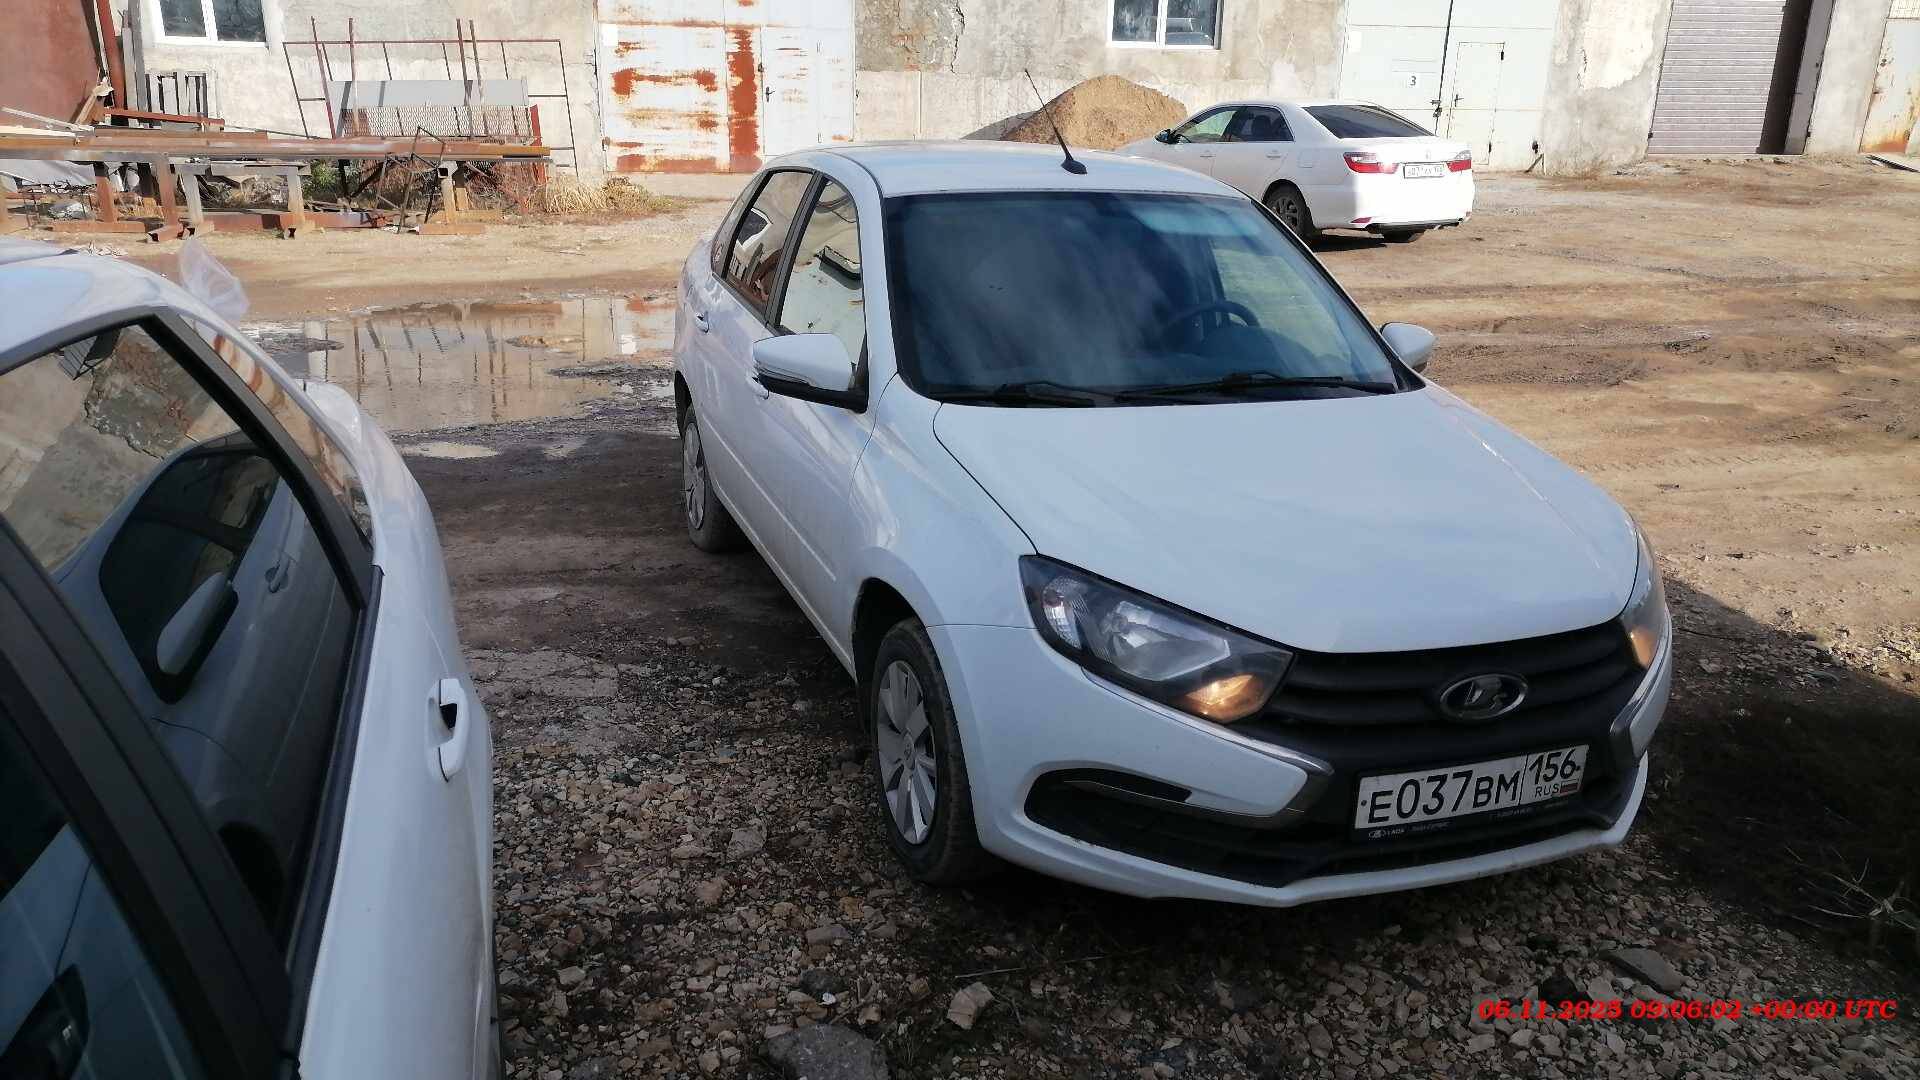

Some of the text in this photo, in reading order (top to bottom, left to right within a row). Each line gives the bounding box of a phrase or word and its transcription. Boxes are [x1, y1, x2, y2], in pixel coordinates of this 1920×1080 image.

[1409, 75, 1417, 86] 3
[1367, 750, 1577, 824] Е037ВМ 156
[1534, 783, 1560, 799] RUS
